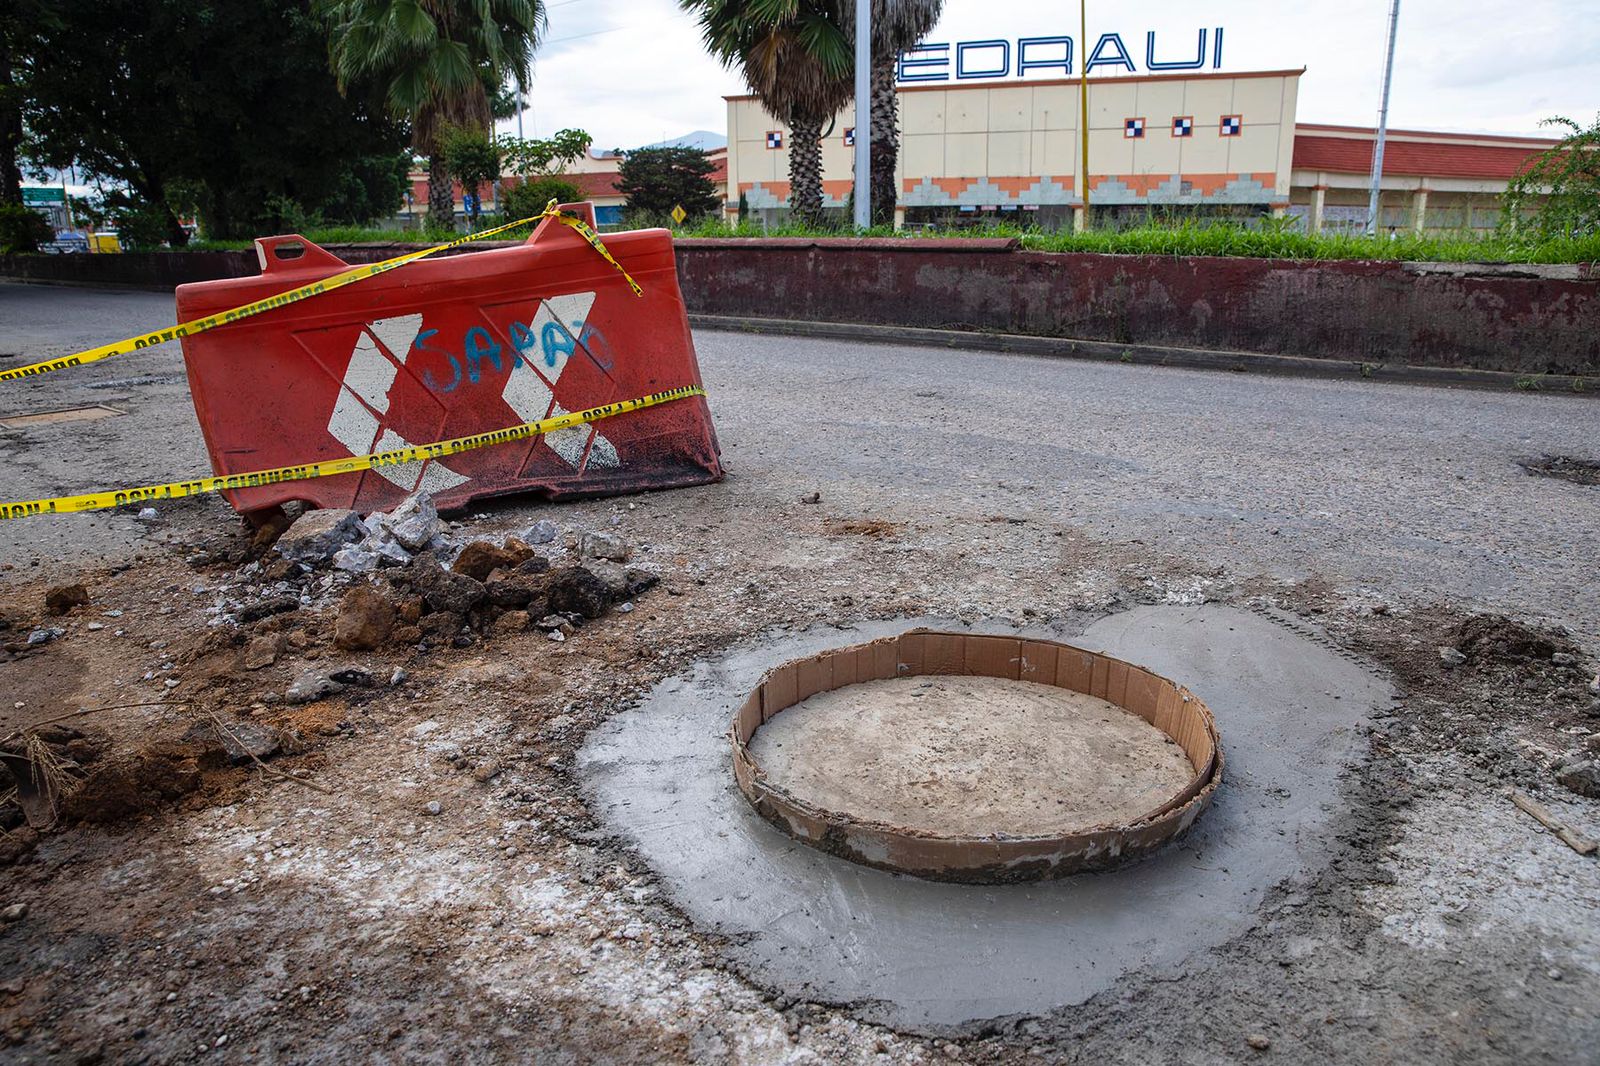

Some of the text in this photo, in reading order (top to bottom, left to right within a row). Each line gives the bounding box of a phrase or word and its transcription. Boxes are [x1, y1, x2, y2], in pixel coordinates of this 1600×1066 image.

[451, 423, 542, 452] PROHIBIDO
[369, 449, 417, 468] PASO
[424, 444, 443, 458] EL
[115, 465, 320, 507] PROHIBIDO EL PASO
